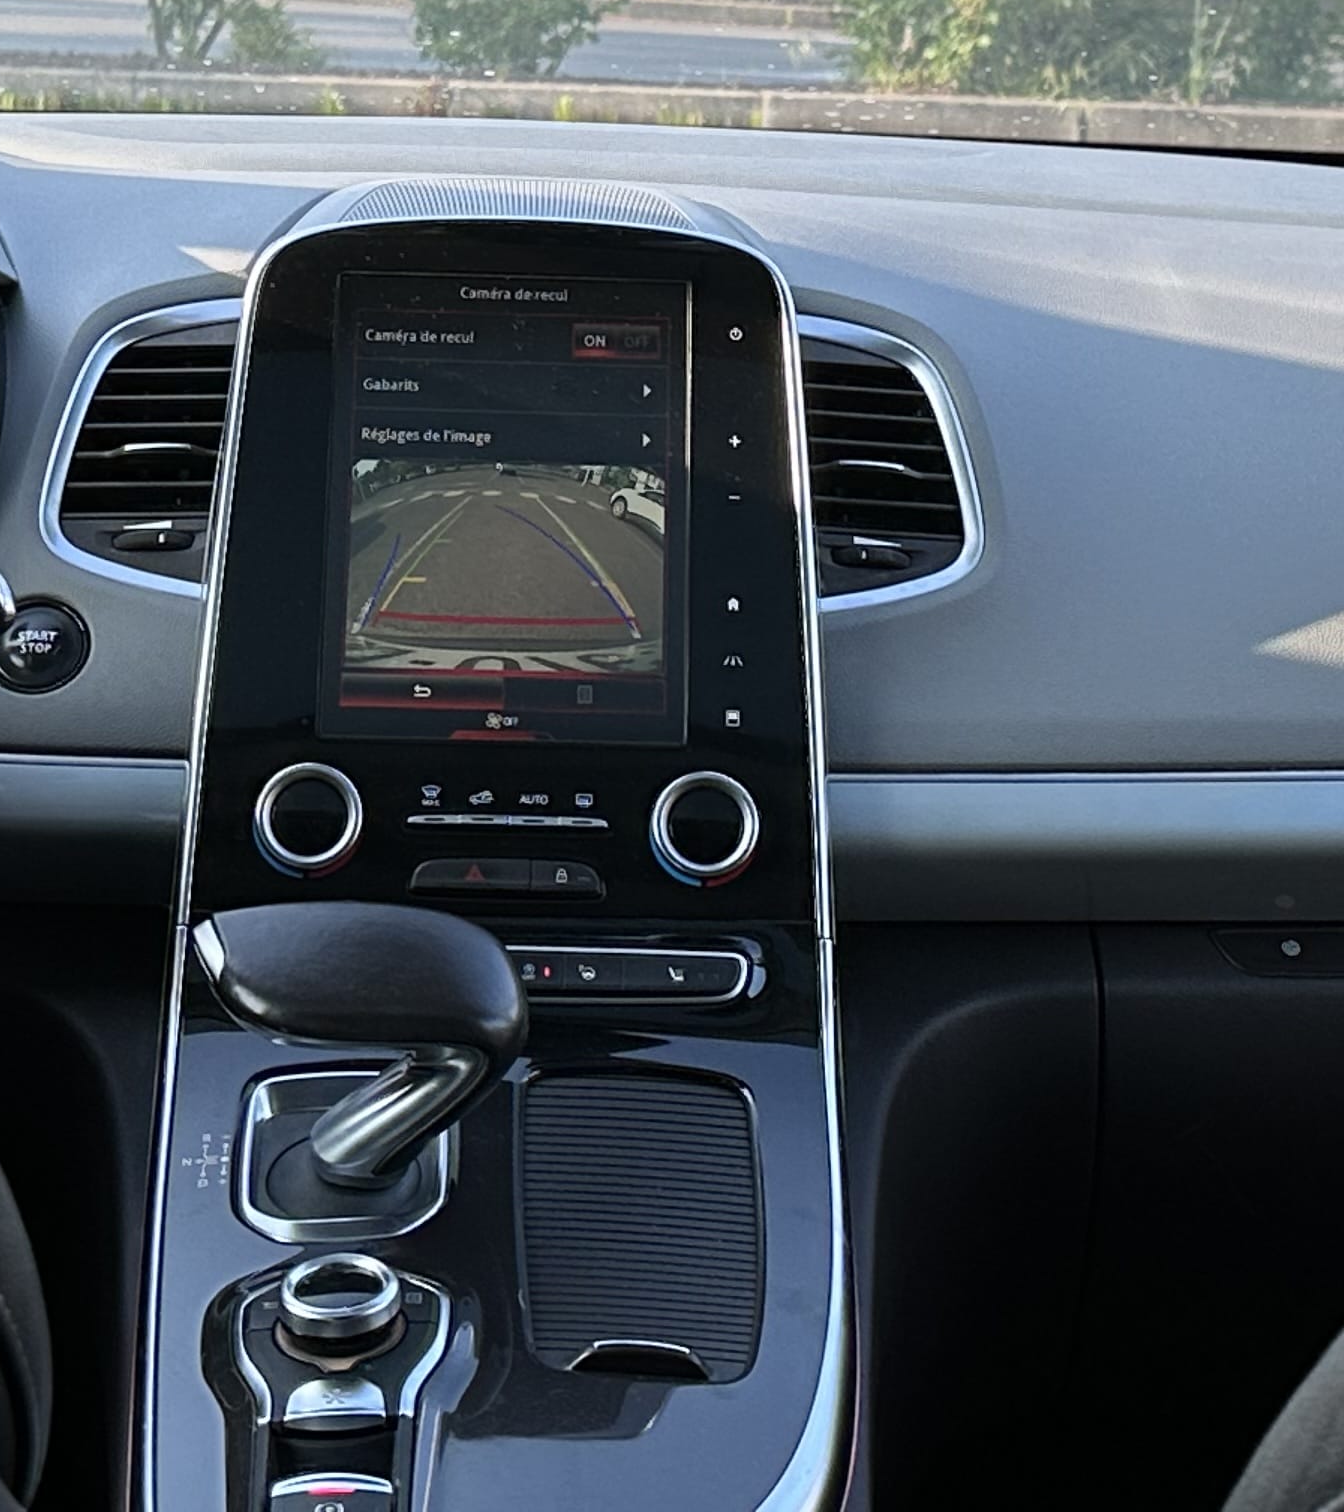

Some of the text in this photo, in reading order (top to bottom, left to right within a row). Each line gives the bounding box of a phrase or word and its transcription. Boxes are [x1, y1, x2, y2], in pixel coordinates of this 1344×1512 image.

[459, 285, 569, 302] Caméra de recul
[364, 327, 475, 345] Caméra de recul
[583, 334, 606, 348] ON
[362, 377, 420, 393] Gabarits
[361, 426, 492, 447] Réglages de l'image
[17, 629, 58, 642] START
[19, 642, 52, 654] STOP
[518, 793, 550, 806] AUTO
